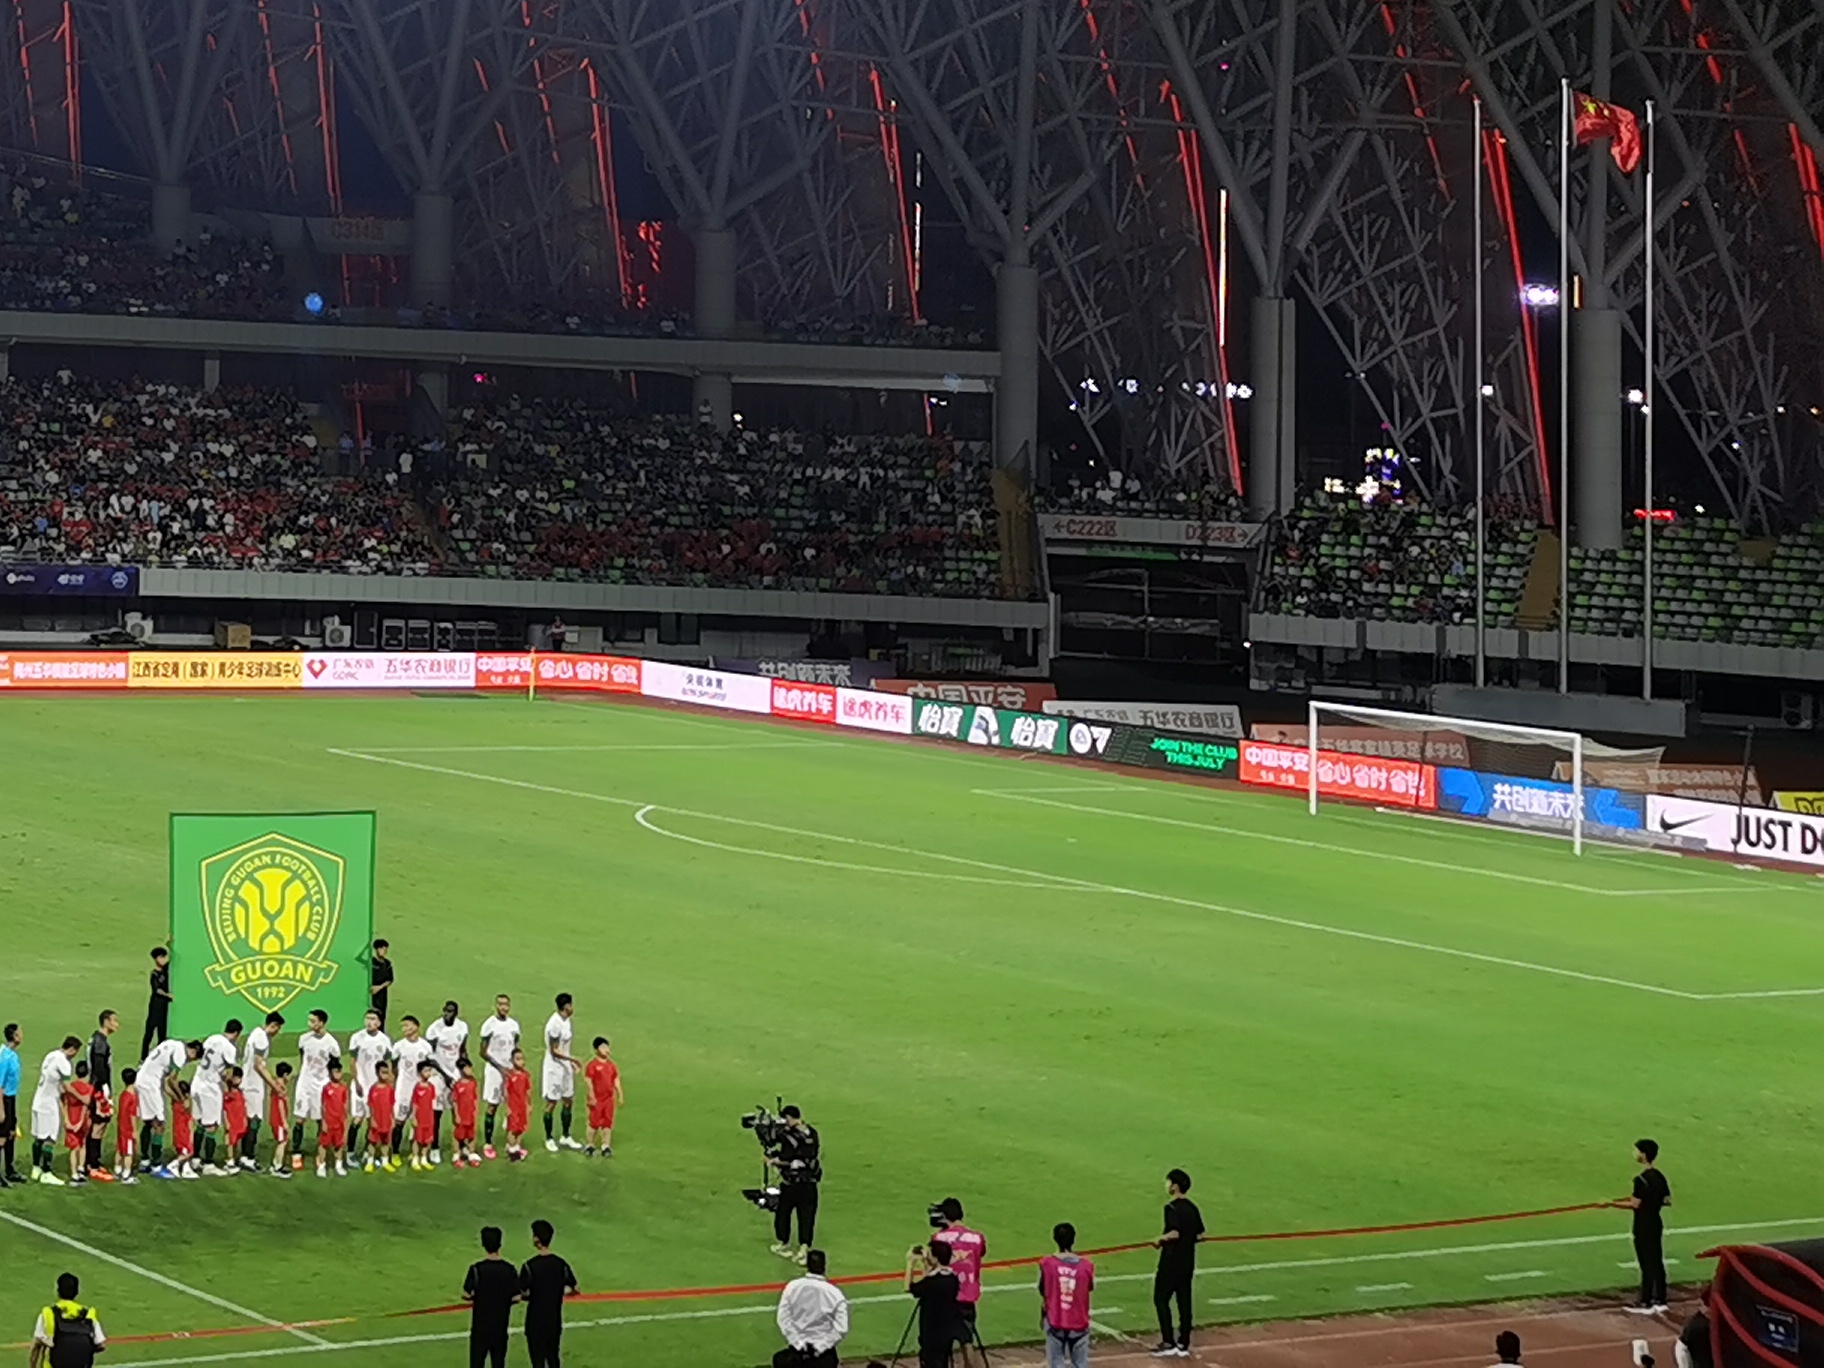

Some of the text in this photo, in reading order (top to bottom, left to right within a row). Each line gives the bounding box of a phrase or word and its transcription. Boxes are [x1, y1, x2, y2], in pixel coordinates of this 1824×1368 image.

[1065, 518, 1116, 537] C222区
[476, 656, 533, 672] 中国平安
[773, 686, 833, 715] 途虎养车
[843, 695, 907, 724] 途虎养车
[1245, 746, 1310, 772] 中国平安
[1730, 814, 1824, 855] JUST D
[230, 962, 314, 984] GUOAN
[256, 986, 287, 1000] 1992
